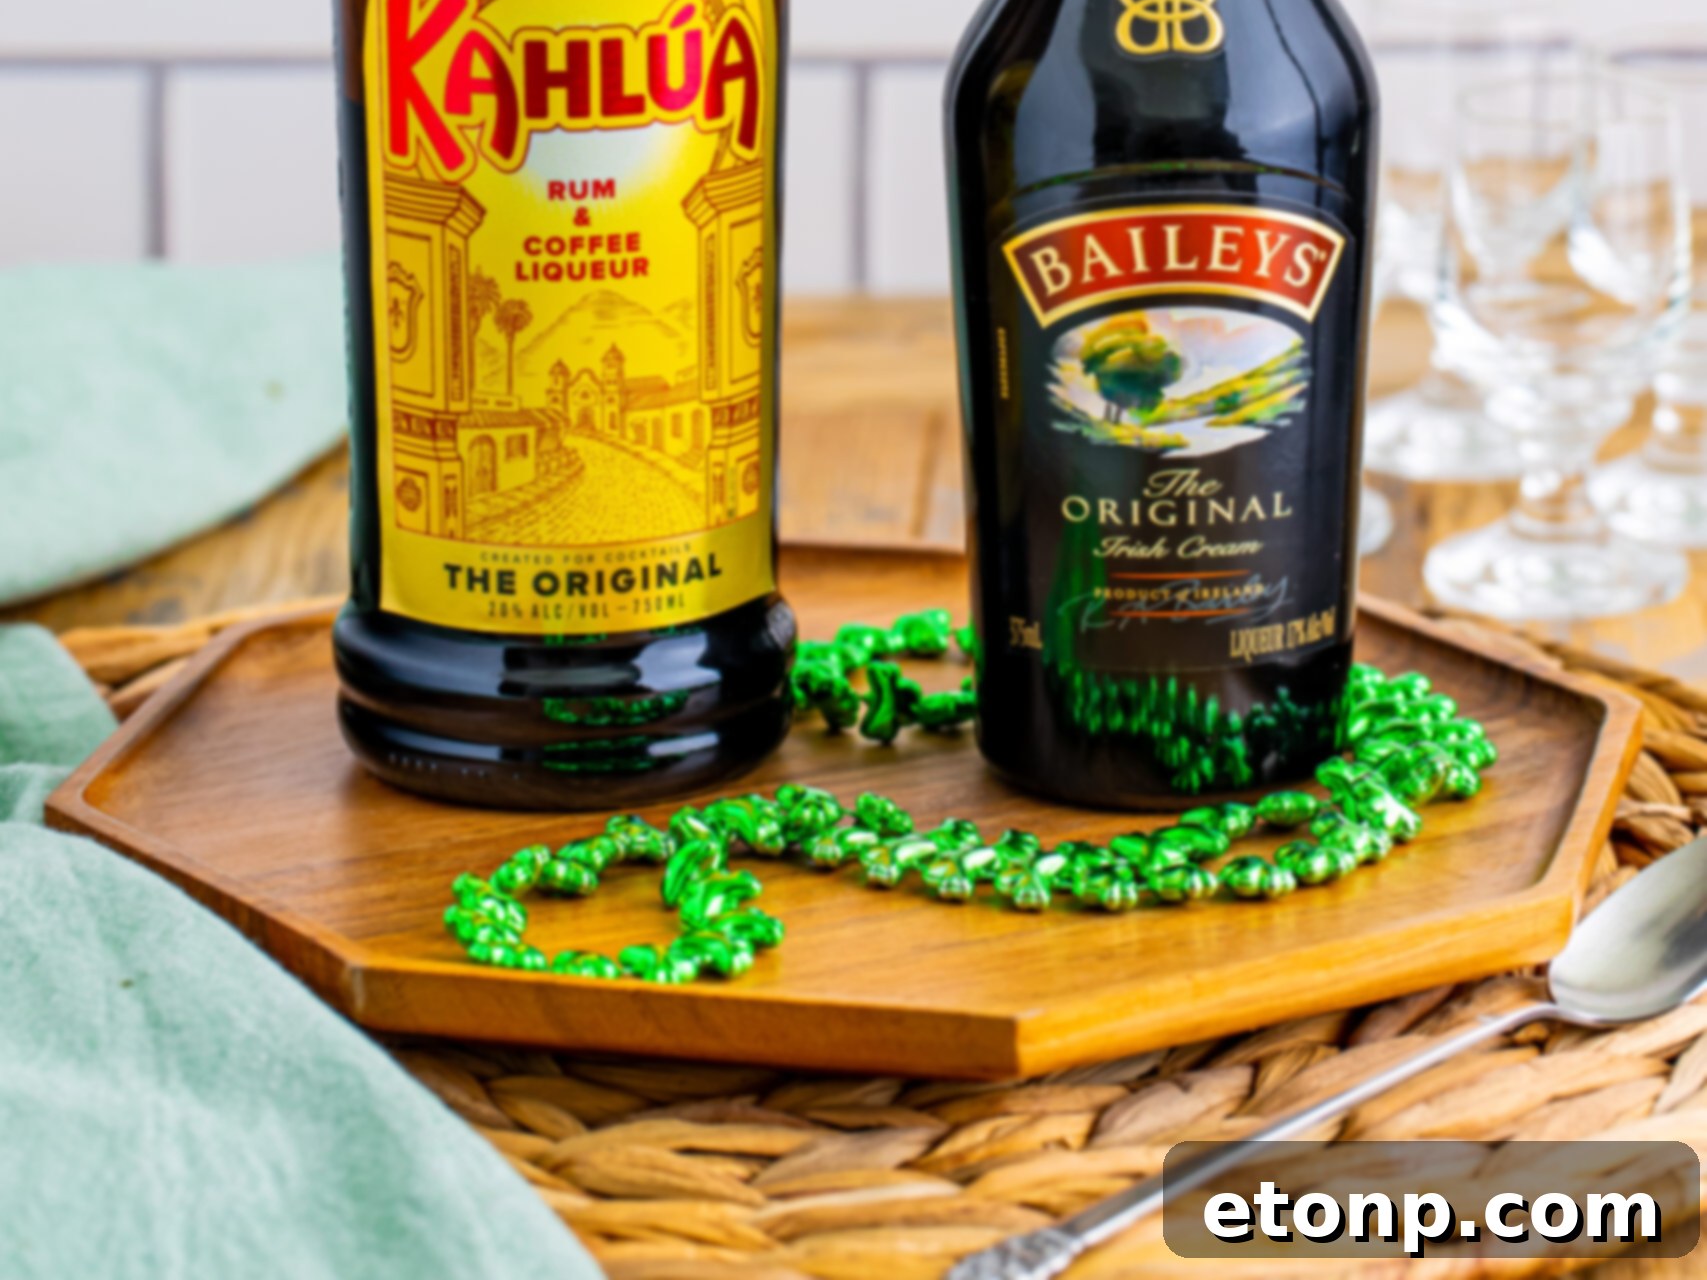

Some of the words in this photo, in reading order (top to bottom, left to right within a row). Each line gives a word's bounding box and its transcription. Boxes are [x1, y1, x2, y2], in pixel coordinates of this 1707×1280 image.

[547, 178, 617, 202] RUM
[572, 206, 591, 227] &
[522, 231, 642, 258] COFFEE
[514, 257, 650, 283] LIQUEUR
[1029, 224, 1321, 298] BAILEYS
[1142, 467, 1224, 499] The
[1060, 491, 1293, 526] ORIGINAL
[480, 550, 554, 566] CREATED
[562, 552, 596, 565] FOR
[604, 542, 692, 564] COCKTAILS
[1092, 534, 1170, 560] Irish
[1176, 534, 1264, 560] Cream
[444, 562, 517, 596] THE
[532, 553, 723, 598] ORIGINAL
[1093, 586, 1171, 601] PRODUCT
